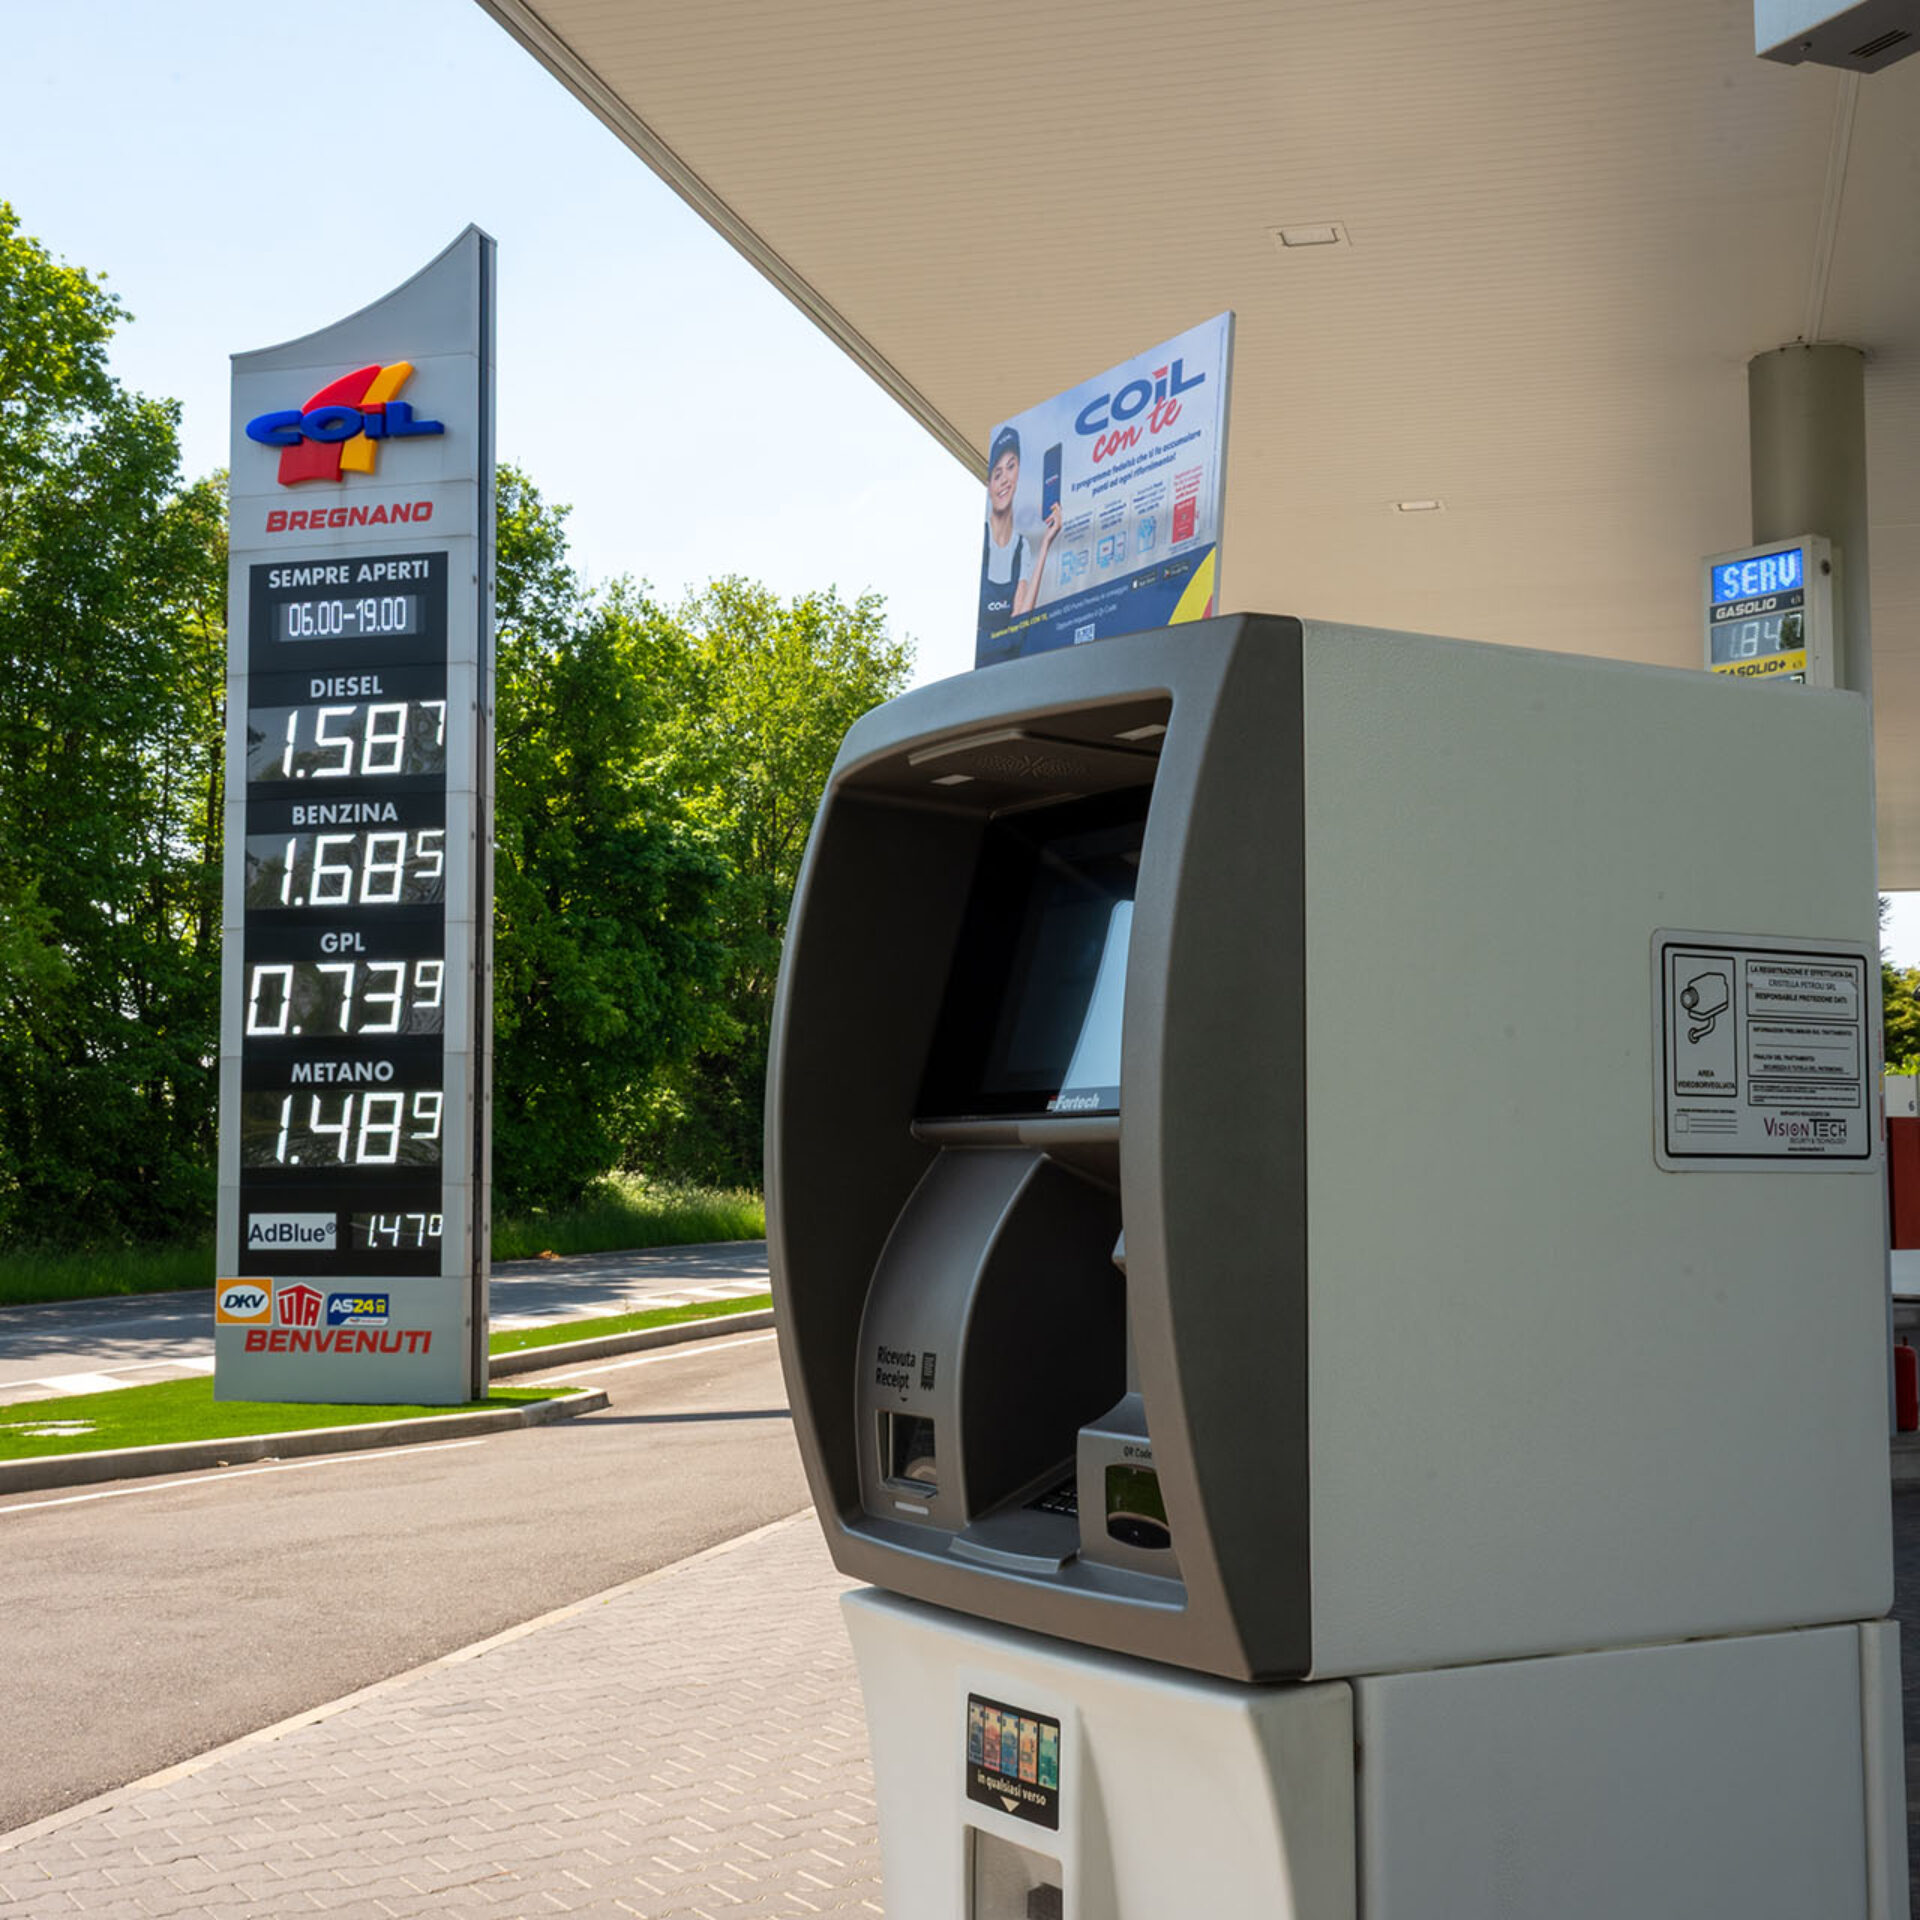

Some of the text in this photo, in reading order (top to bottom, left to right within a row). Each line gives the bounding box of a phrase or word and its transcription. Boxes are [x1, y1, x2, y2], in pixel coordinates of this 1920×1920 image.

[1092, 395, 1183, 463] con te
[1077, 470, 1112, 491] programma
[1136, 453, 1147, 464] che
[265, 501, 434, 533] BREGNANO
[268, 560, 430, 588] SEMPRE APERTI
[1723, 554, 1796, 599] SERV
[288, 597, 407, 637] 06.00-19.00
[1716, 597, 1777, 619] GASOLIO
[310, 675, 383, 698] DIESEL
[292, 802, 398, 826] BENZINA
[320, 932, 366, 953] GPL
[291, 1061, 394, 1083] METANO
[1697, 1069, 1715, 1078] AREA
[1054, 1093, 1100, 1111] Fortech
[224, 1294, 265, 1309] DKV
[276, 1284, 324, 1327] UTA
[329, 1299, 374, 1314] AS24
[244, 1329, 433, 1354] BENVENUTI
[877, 1345, 916, 1367] Ricevuta
[875, 1367, 909, 1392] Receipt
[1123, 1446, 1134, 1457] QR
[977, 1768, 1047, 1806] in qualsiasi verso
